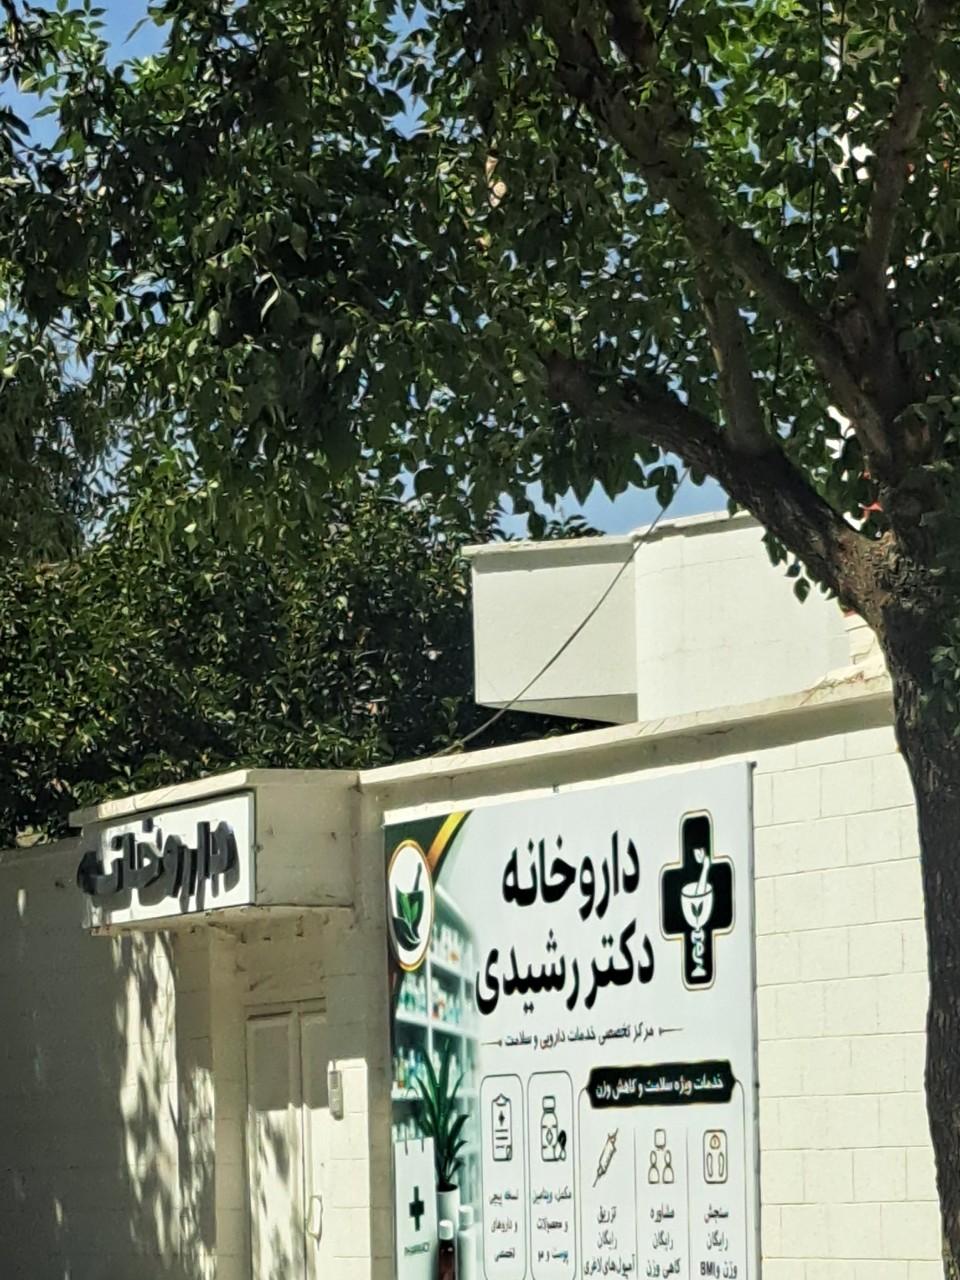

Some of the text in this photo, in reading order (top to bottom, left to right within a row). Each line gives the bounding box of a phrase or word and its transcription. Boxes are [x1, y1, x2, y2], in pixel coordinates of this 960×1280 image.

[77, 816, 240, 911] داروخانه
[502, 830, 640, 921] داروخانه
[475, 918, 655, 1016] دکتر رشیدی
[505, 1030, 532, 1047] سلامت
[567, 1026, 596, 1043] خدمات
[599, 1024, 631, 1046] تخصصی
[632, 1021, 654, 1043] مرکز
[595, 1079, 611, 1100] وزن
[612, 1077, 638, 1100] کاهش
[645, 1076, 673, 1092] سلامت
[674, 1075, 692, 1096] ویژه
[693, 1073, 724, 1090] خدمات
[650, 1202, 675, 1223] مشاوره
[704, 1203, 729, 1224] سنجش
[597, 1229, 618, 1250] رایگان
[652, 1229, 674, 1251] رایگان
[706, 1229, 729, 1251] رایگان
[646, 1260, 660, 1278] وزن
[723, 1260, 738, 1280] وزن
